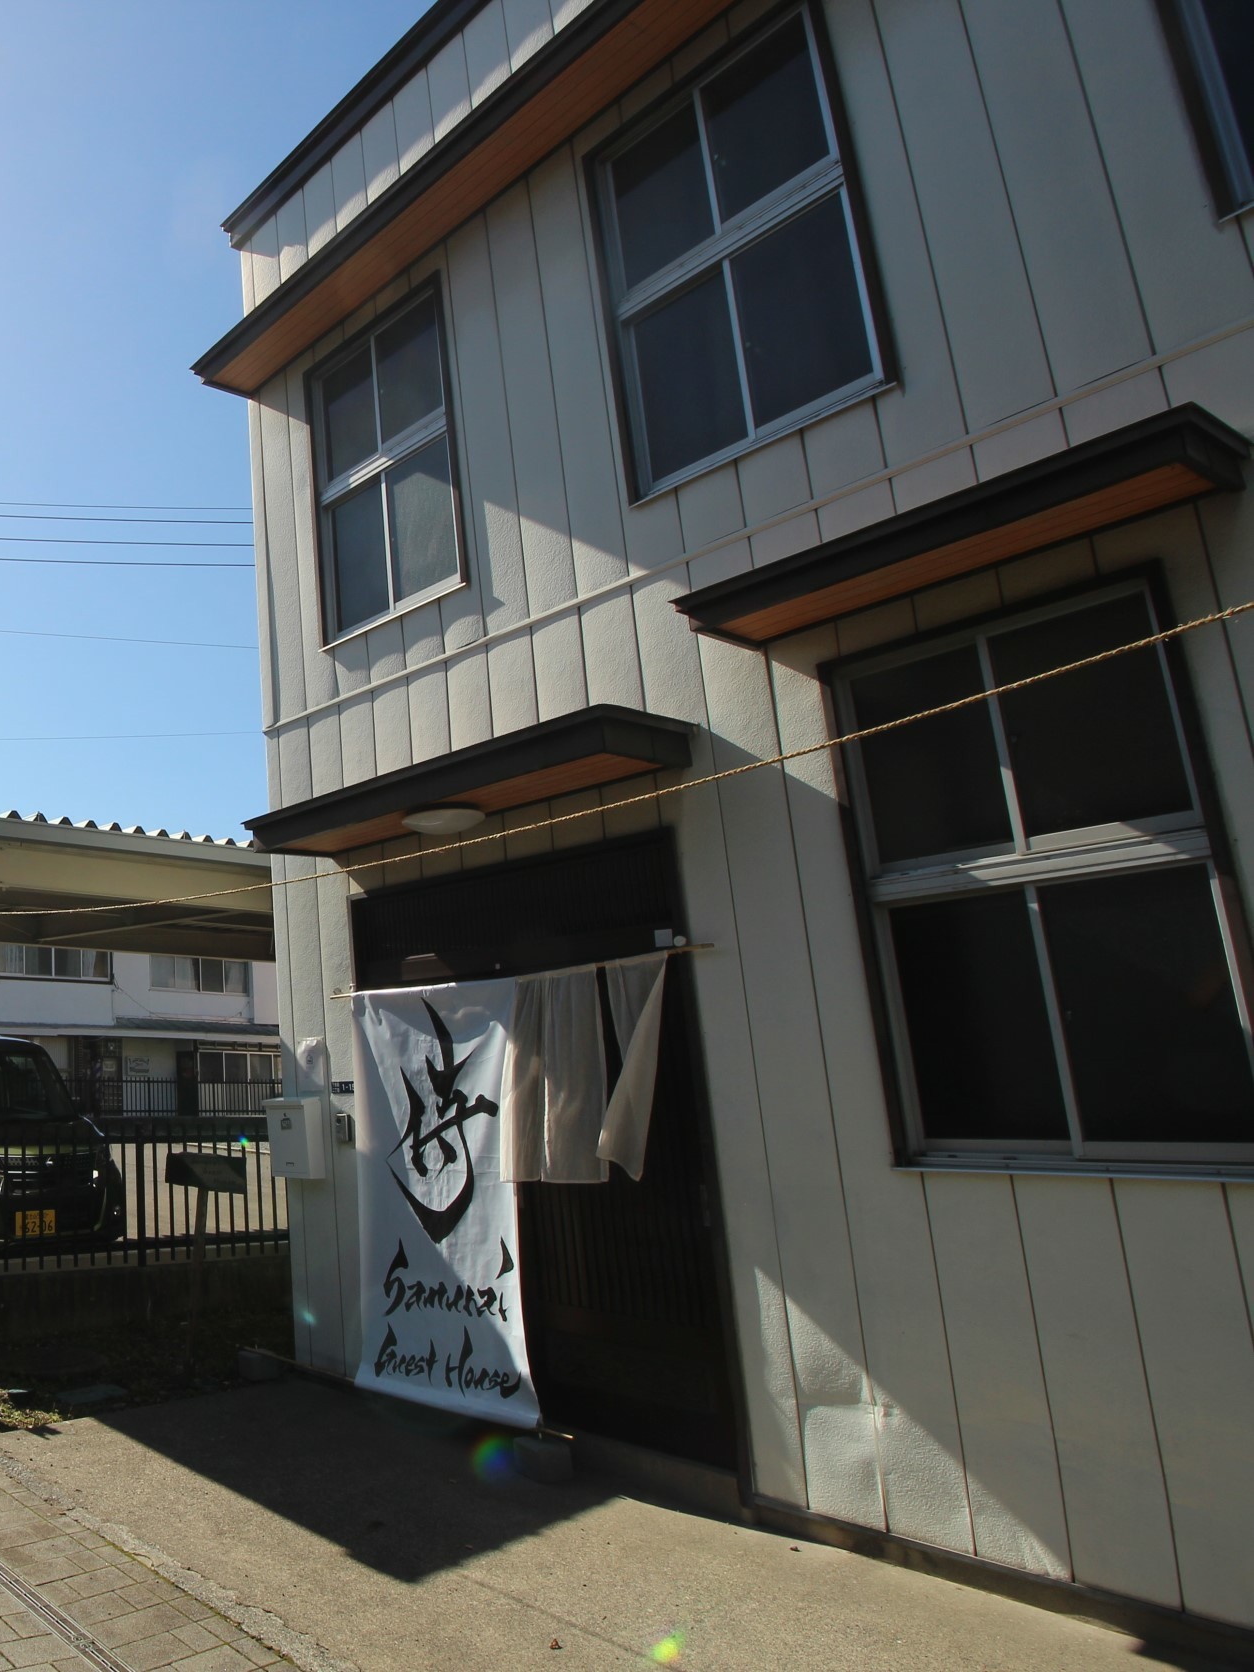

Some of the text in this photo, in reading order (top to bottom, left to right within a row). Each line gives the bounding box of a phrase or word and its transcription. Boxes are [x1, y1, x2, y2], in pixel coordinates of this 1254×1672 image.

[386, 997, 498, 1244] 侍
[383, 1237, 514, 1322] Samurai
[374, 1321, 522, 1399] Guest House
